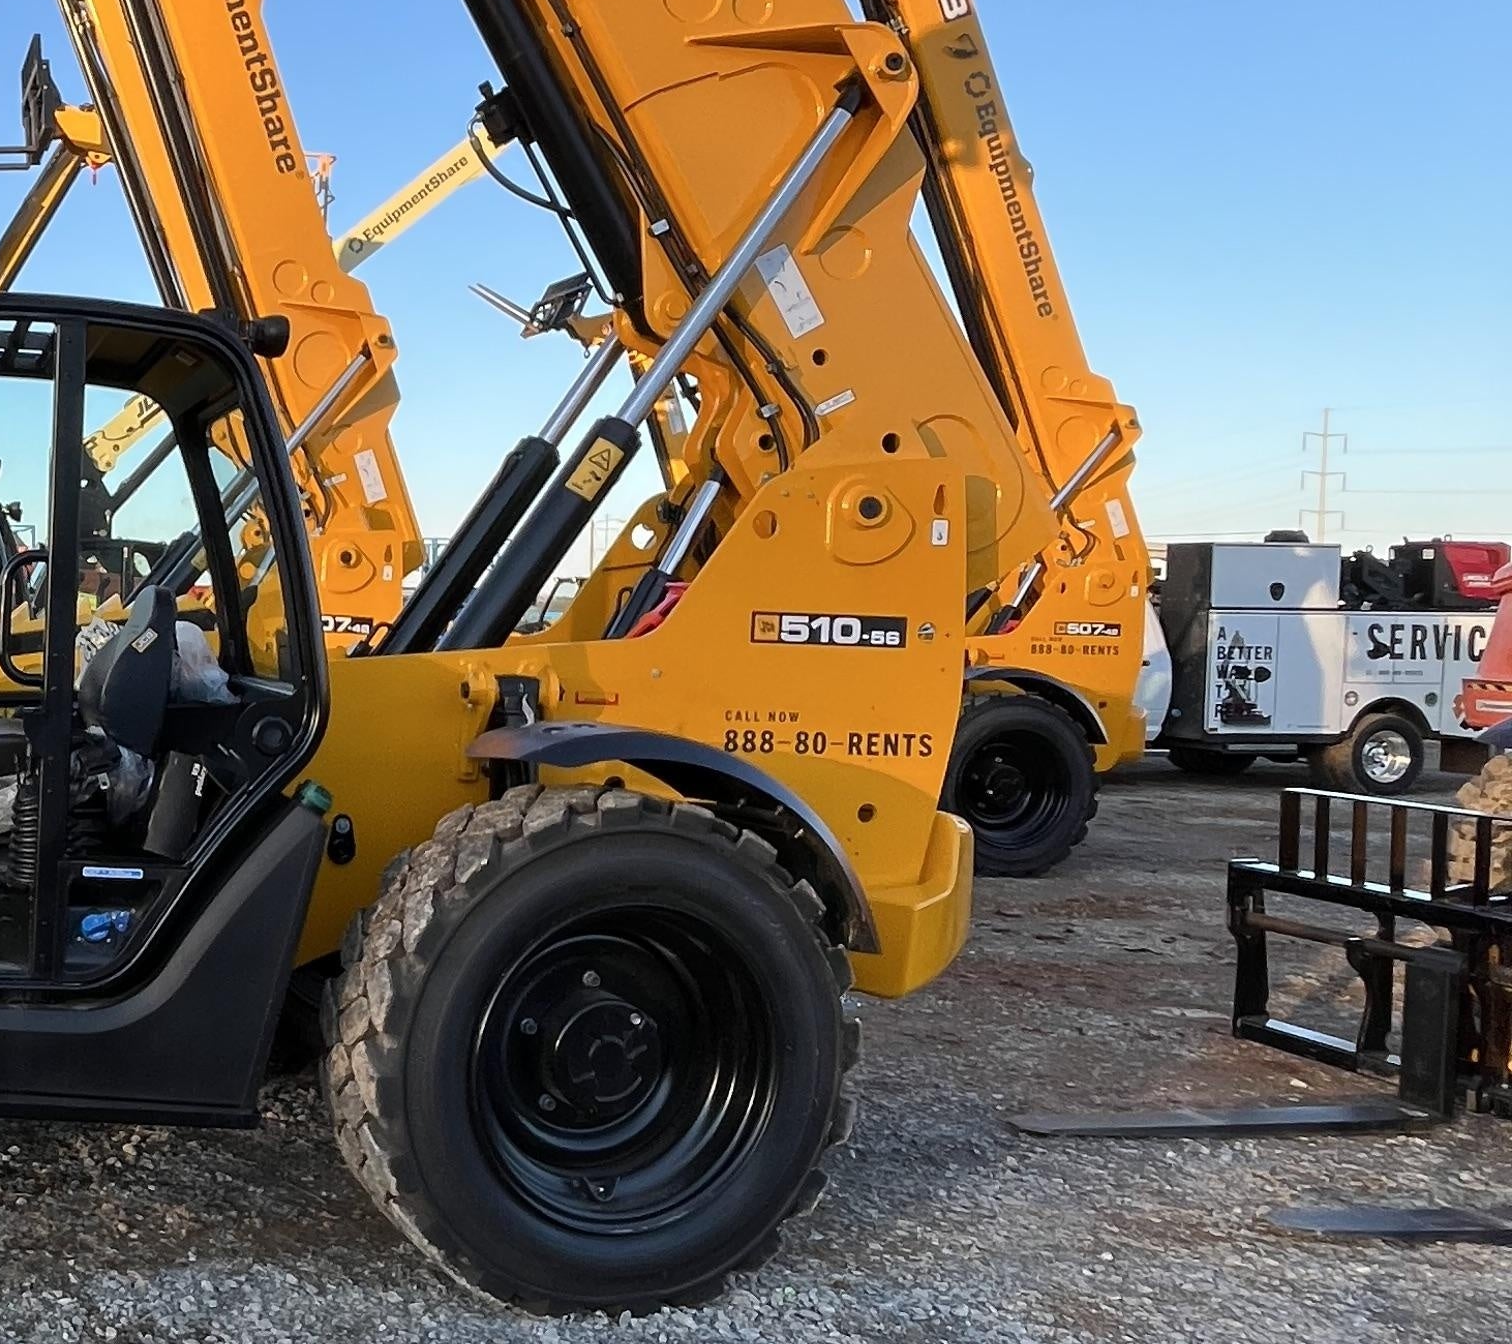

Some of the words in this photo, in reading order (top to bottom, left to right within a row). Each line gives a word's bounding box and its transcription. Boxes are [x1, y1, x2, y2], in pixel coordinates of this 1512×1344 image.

[361, 155, 469, 244] EquipmentShare
[975, 103, 1053, 319] EquipmentShare
[137, 397, 157, 418] JL
[780, 615, 901, 646] 510-56
[1216, 626, 1227, 641] A
[1365, 622, 1486, 662] SERVIC
[1216, 645, 1273, 661] BETTER
[724, 709, 760, 723] CALL
[767, 711, 800, 723] NOW
[723, 729, 934, 758] 888-80-RENTS
